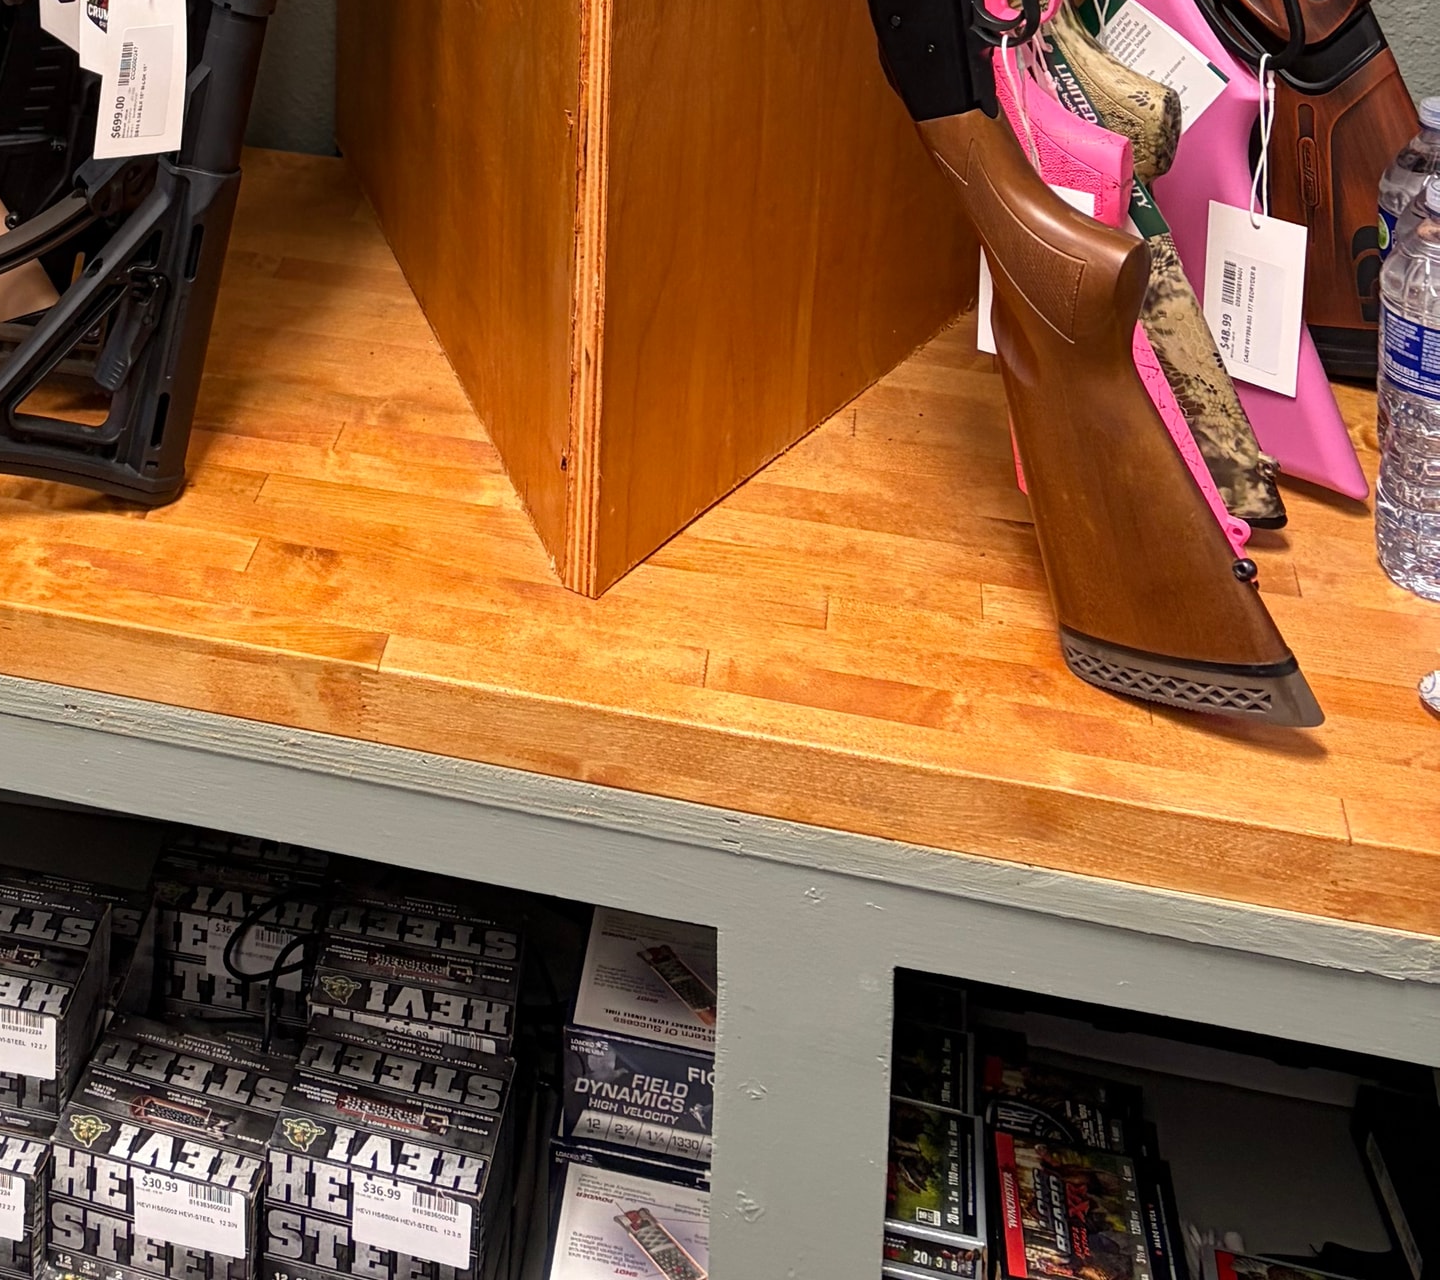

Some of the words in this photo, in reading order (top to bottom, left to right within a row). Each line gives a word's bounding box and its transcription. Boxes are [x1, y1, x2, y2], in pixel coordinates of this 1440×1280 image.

[1054, 64, 1098, 123] LIMITED
[110, 95, 125, 138] $699.00
[1219, 312, 1234, 351] $48.99
[329, 904, 518, 960] STEEL
[365, 980, 511, 1034] HEVI
[571, 1039, 594, 1048] LOADED
[104, 1041, 289, 1112] STEEL
[310, 1042, 506, 1110] STEEL
[632, 1074, 689, 1099] FIELD
[574, 1077, 685, 1114] DYNAMICS
[588, 1097, 618, 1112] HIGH
[623, 1104, 679, 1125] VELOCITY
[586, 1118, 601, 1129] 12
[672, 1135, 699, 1150] 1330
[108, 1123, 262, 1191] HEVI
[327, 1126, 485, 1194] HEVI
[142, 1175, 179, 1193] $30.99
[362, 1181, 401, 1200] $36.99
[1003, 1172, 1018, 1228] WINCHESTER
[179, 1210, 215, 1225] HEVI-STEEL
[400, 1217, 438, 1233] HEVI-STEEL
[58, 1254, 72, 1265] 12
[913, 1250, 928, 1264] 20
